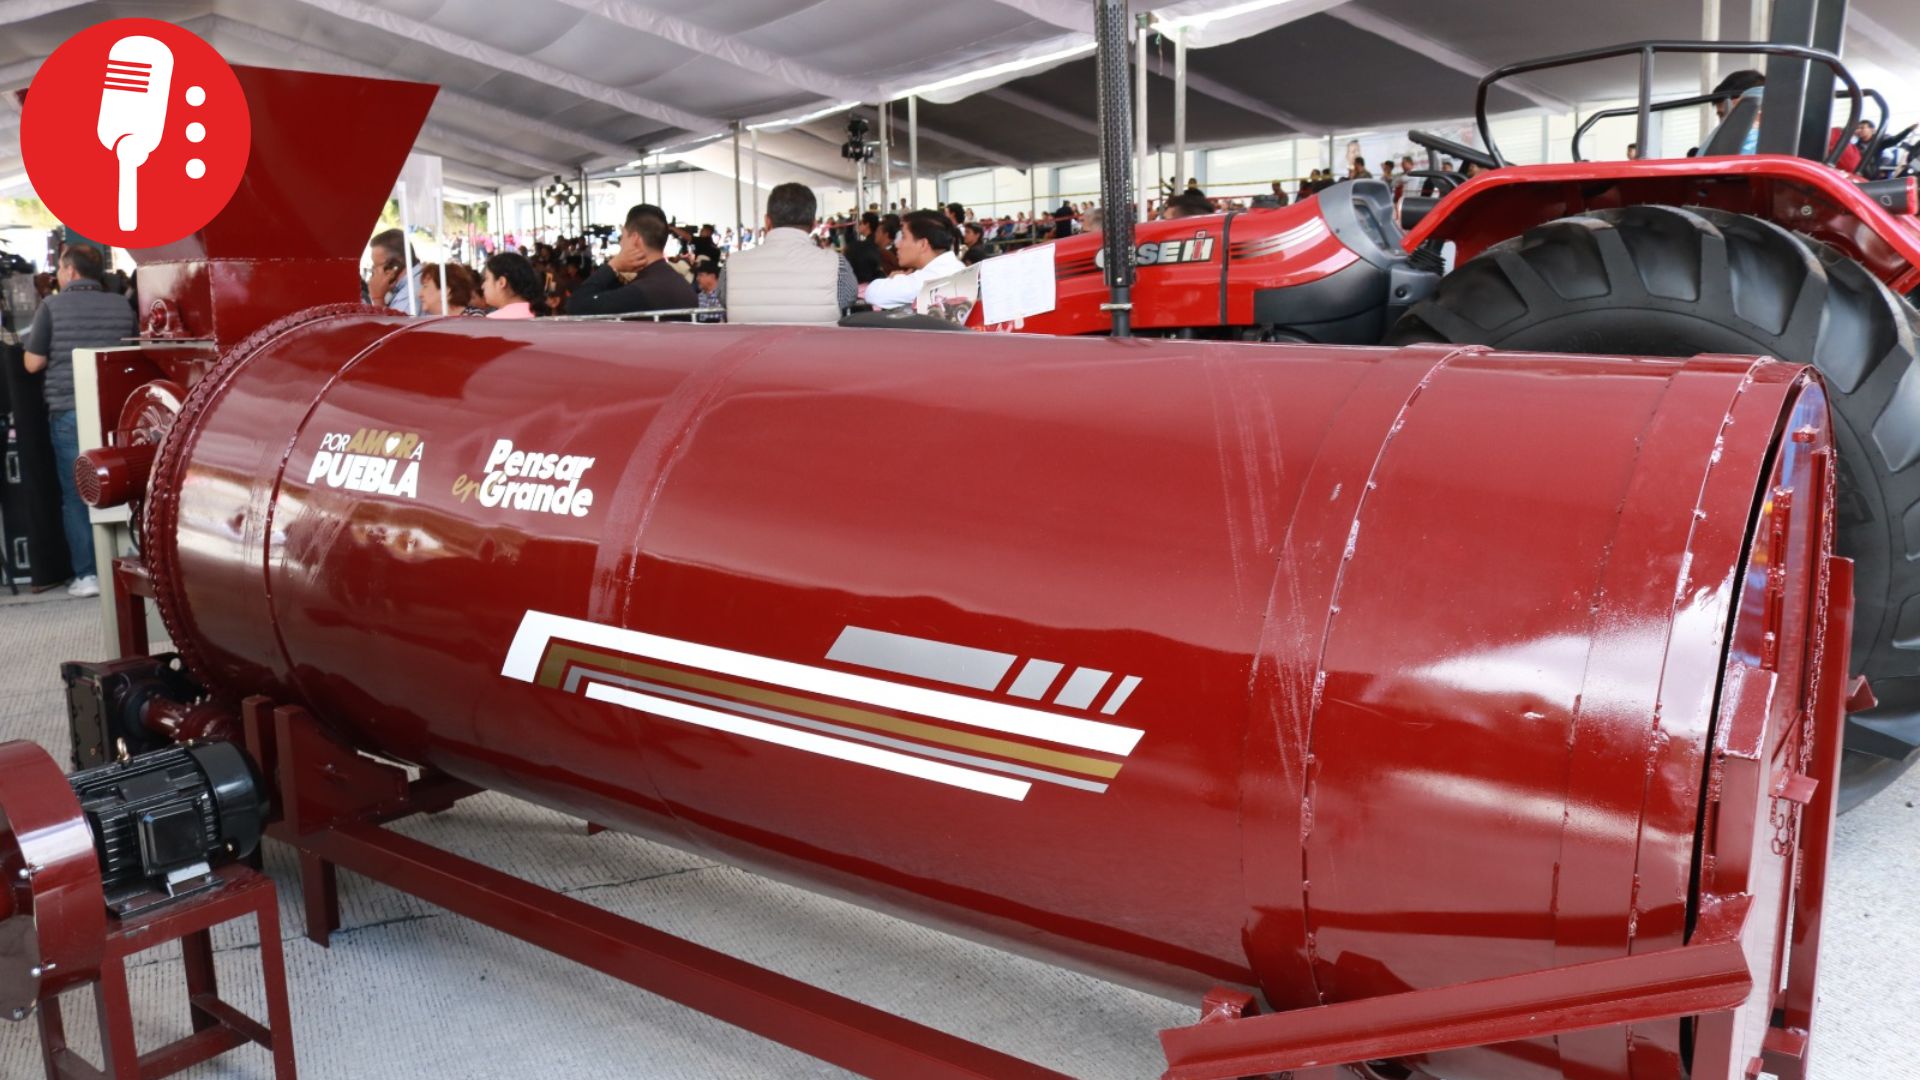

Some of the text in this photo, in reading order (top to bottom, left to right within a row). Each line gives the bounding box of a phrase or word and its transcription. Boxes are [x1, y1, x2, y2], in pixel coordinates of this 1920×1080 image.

[1095, 240, 1181, 269] SE
[319, 428, 424, 461] POR AMOR A
[483, 439, 595, 481] Pensar
[306, 450, 420, 499] PUEBLA
[452, 470, 594, 517] en Grande
